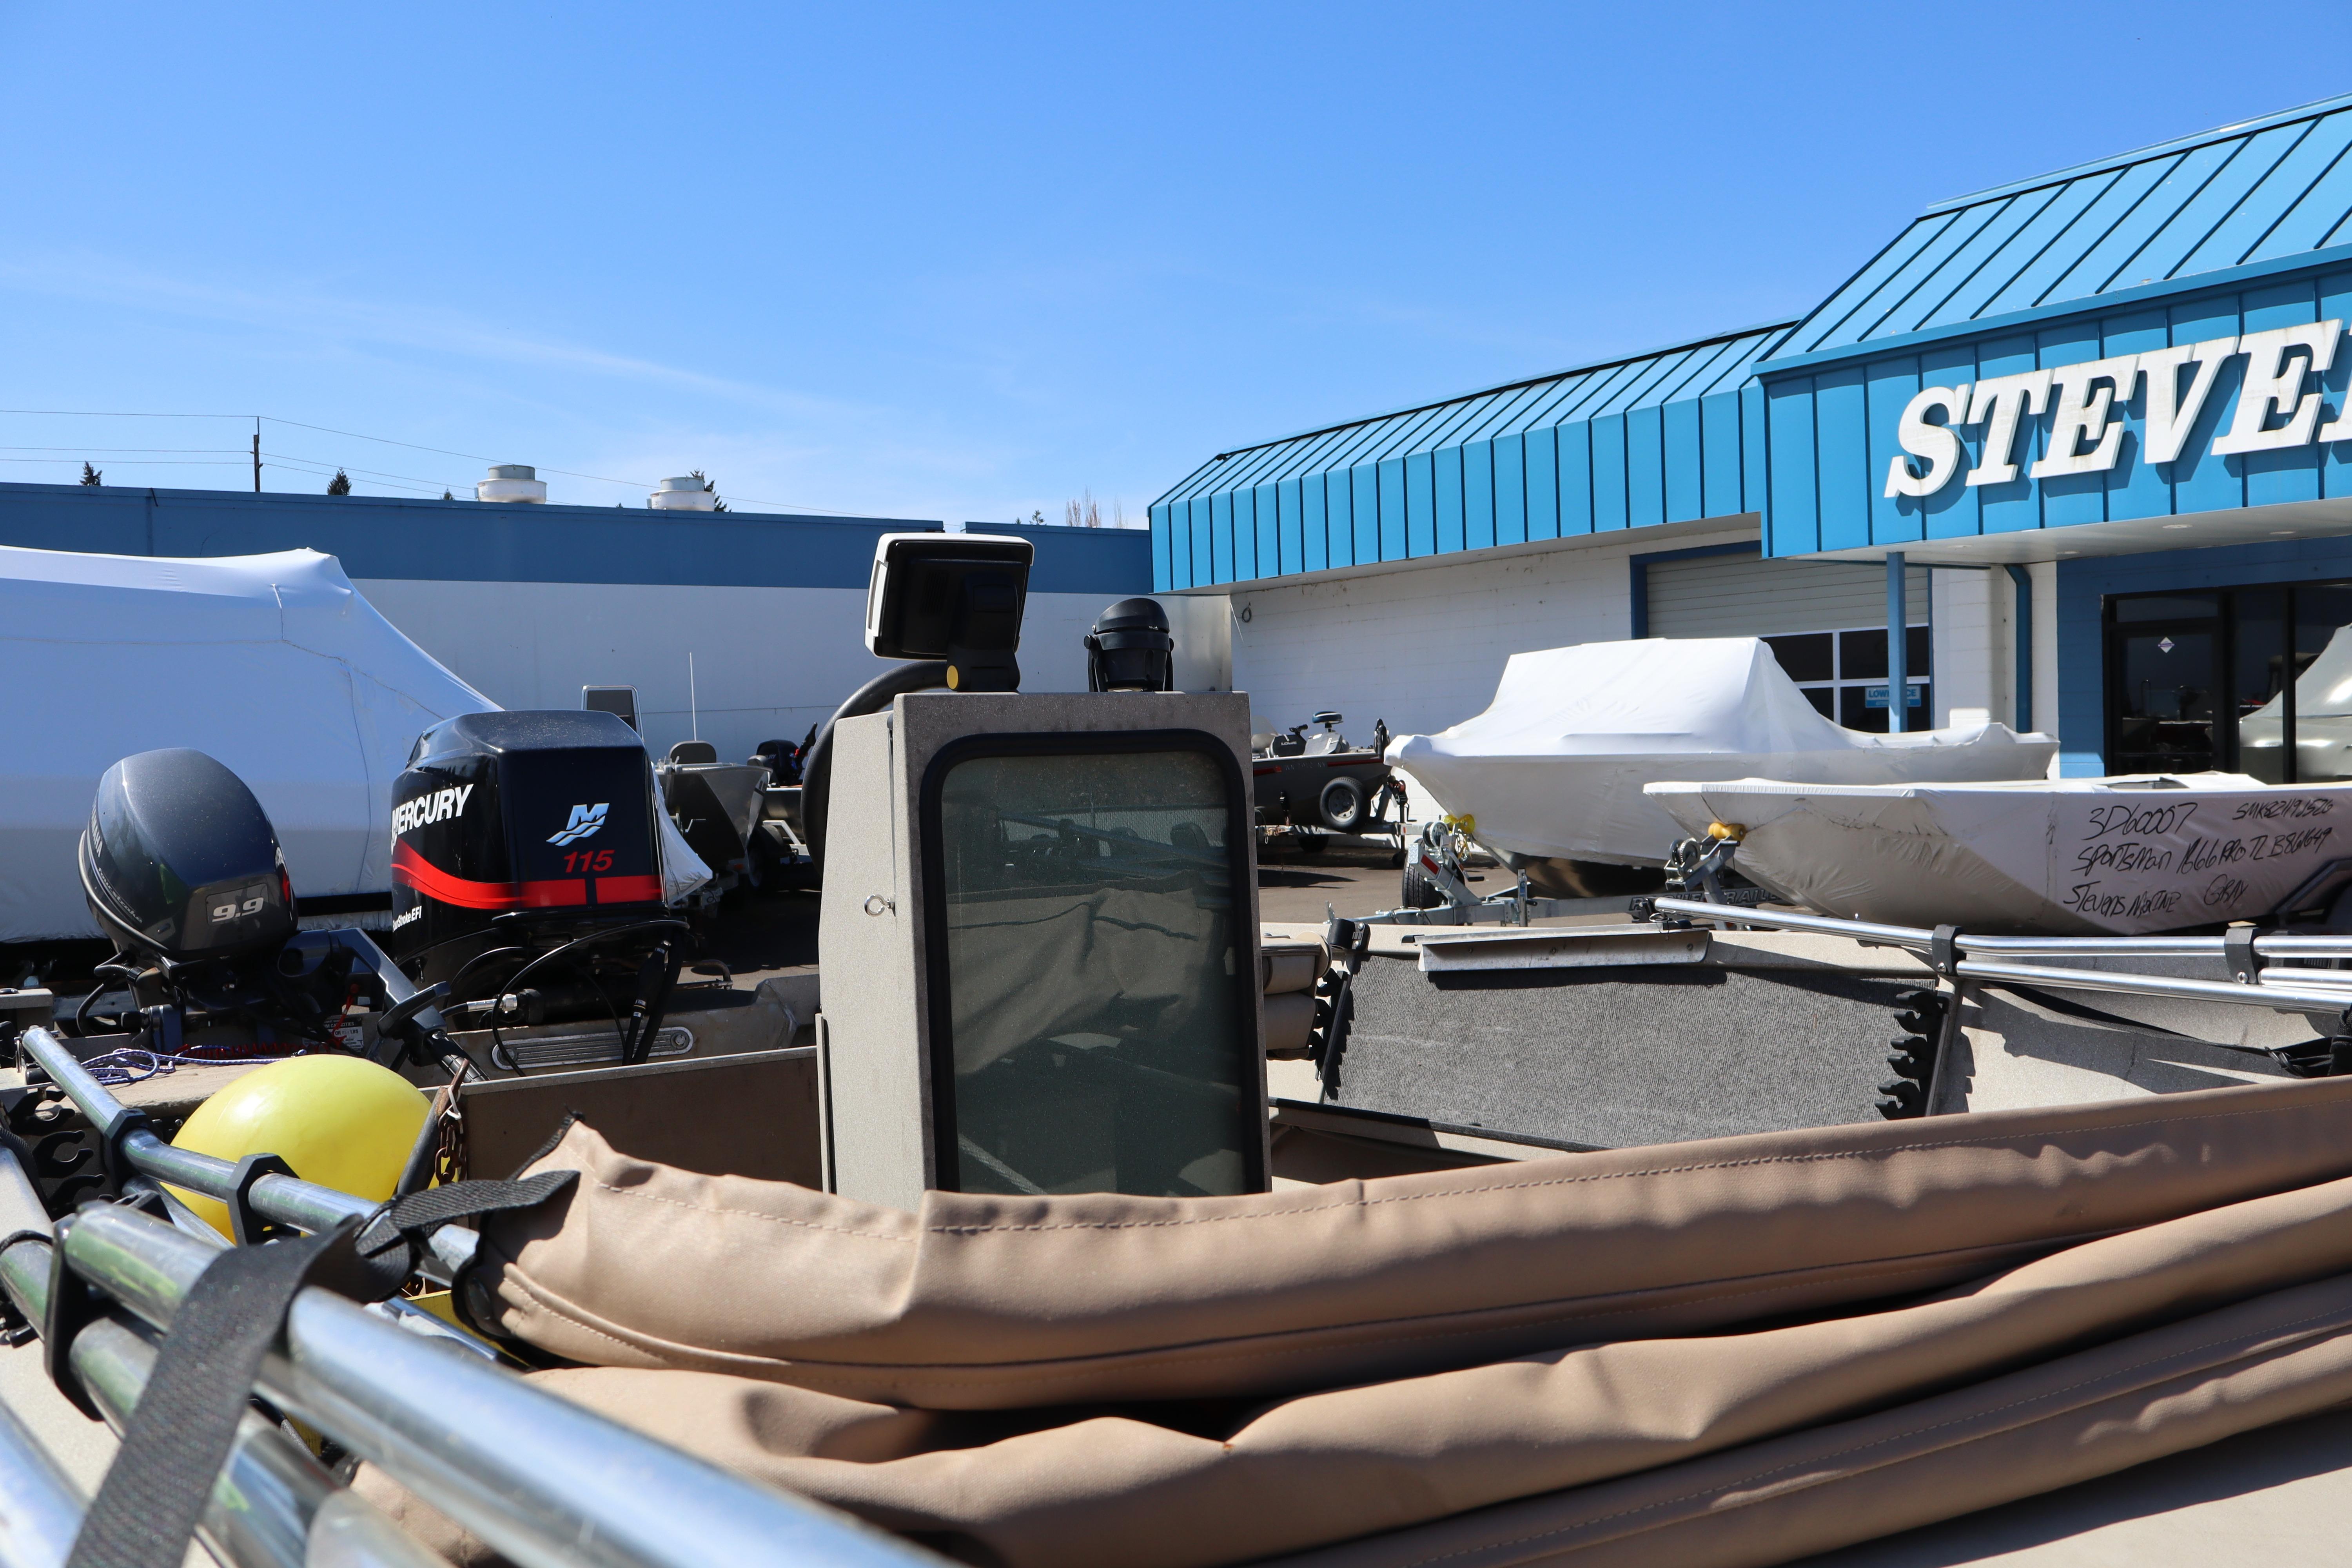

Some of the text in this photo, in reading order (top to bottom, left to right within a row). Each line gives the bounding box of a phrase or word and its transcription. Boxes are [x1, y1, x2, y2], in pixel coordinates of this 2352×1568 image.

[1869, 689, 1916, 697] LOWCE
[392, 784, 474, 849] MERCURY
[91, 804, 103, 858] AMAHA
[564, 849, 615, 873] 115
[212, 897, 263, 922] 9.9
[411, 906, 422, 921] EFI
